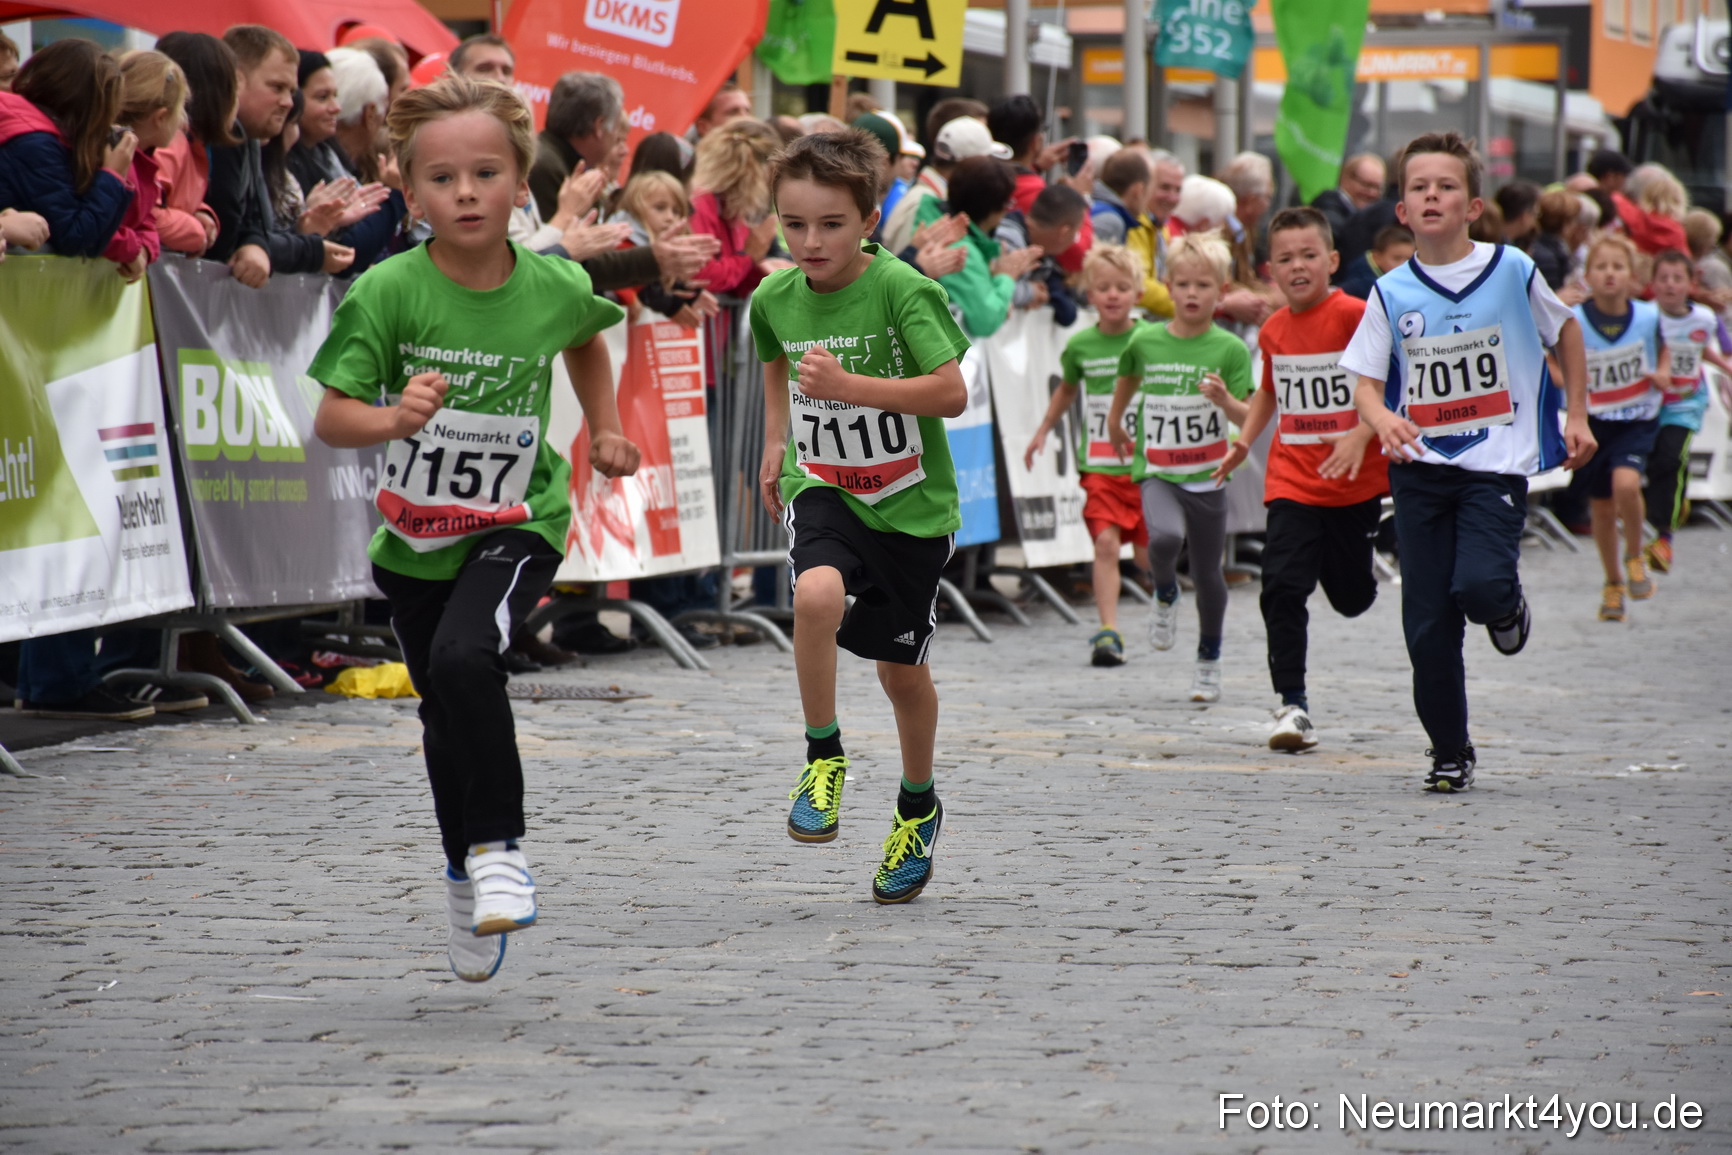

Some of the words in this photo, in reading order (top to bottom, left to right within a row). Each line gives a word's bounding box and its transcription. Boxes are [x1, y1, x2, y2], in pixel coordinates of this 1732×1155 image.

[592, 0, 669, 35] DKMS
[547, 32, 570, 49] Wir
[571, 39, 630, 66] besiegen
[632, 53, 698, 85] Blutkrebs.
[1398, 311, 1425, 338] 9
[1432, 340, 1485, 356] Neumarkt
[1295, 362, 1338, 373] Neumarkt
[1415, 352, 1498, 399] 7019
[1589, 357, 1645, 389] 7402
[1280, 374, 1351, 409] 7105
[1151, 411, 1221, 445] 7154
[1435, 404, 1478, 422] Jonas
[433, 423, 511, 445] Neumarkt
[802, 410, 907, 460] 7110
[400, 436, 520, 504] 7157
[1168, 452, 1207, 465] Tobias
[836, 471, 883, 490] Lukas
